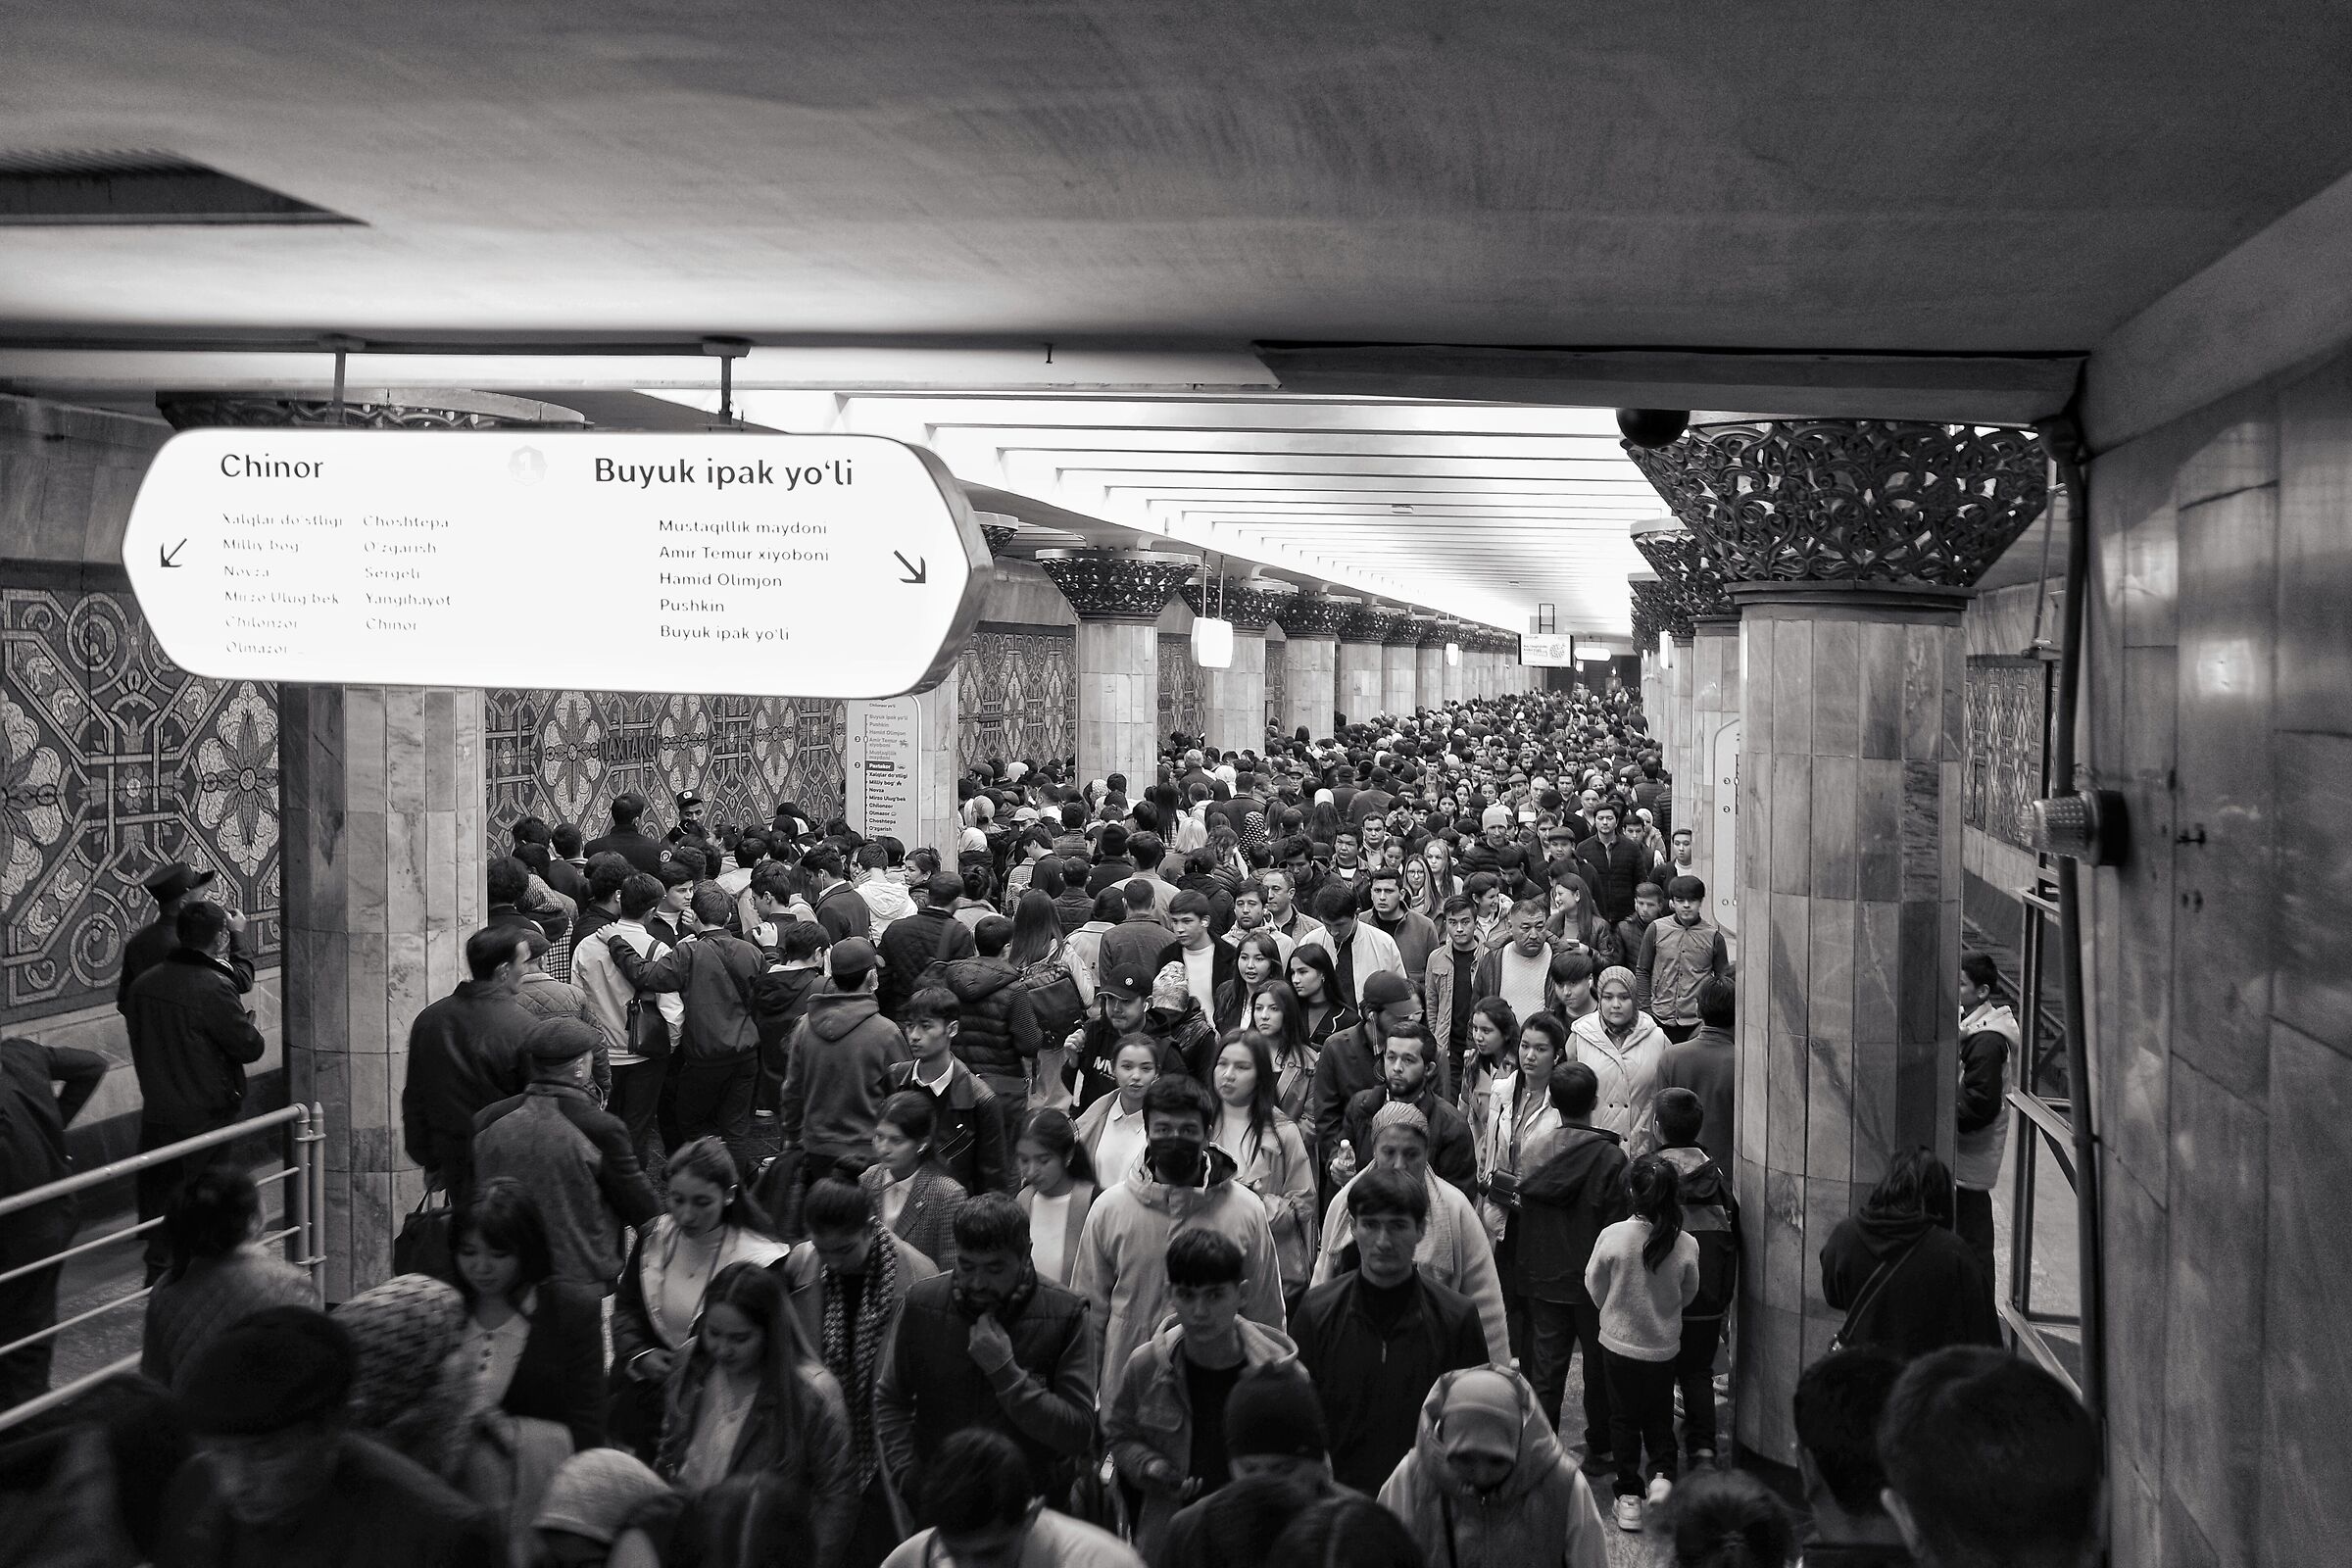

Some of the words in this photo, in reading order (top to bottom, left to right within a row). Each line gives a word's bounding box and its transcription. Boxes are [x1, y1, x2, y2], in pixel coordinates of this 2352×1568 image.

[220, 452, 324, 479] Chinor
[594, 457, 696, 490] Buyuk
[707, 457, 774, 491] ipak
[784, 458, 853, 492] yo‘li
[364, 514, 449, 531] Choshtepa
[659, 519, 751, 536] Mustaqillik
[756, 520, 827, 537] maydoni
[659, 545, 697, 560] Amir
[702, 546, 754, 561] Temur
[758, 546, 830, 564] xiyoboni
[660, 571, 712, 586] Hamid
[716, 572, 783, 590] Olimjon
[660, 598, 725, 612] Pushkin
[366, 616, 416, 631] Chinor
[661, 624, 710, 642] Buyuk
[716, 625, 750, 642] ipak
[755, 626, 790, 644] yo‘li
